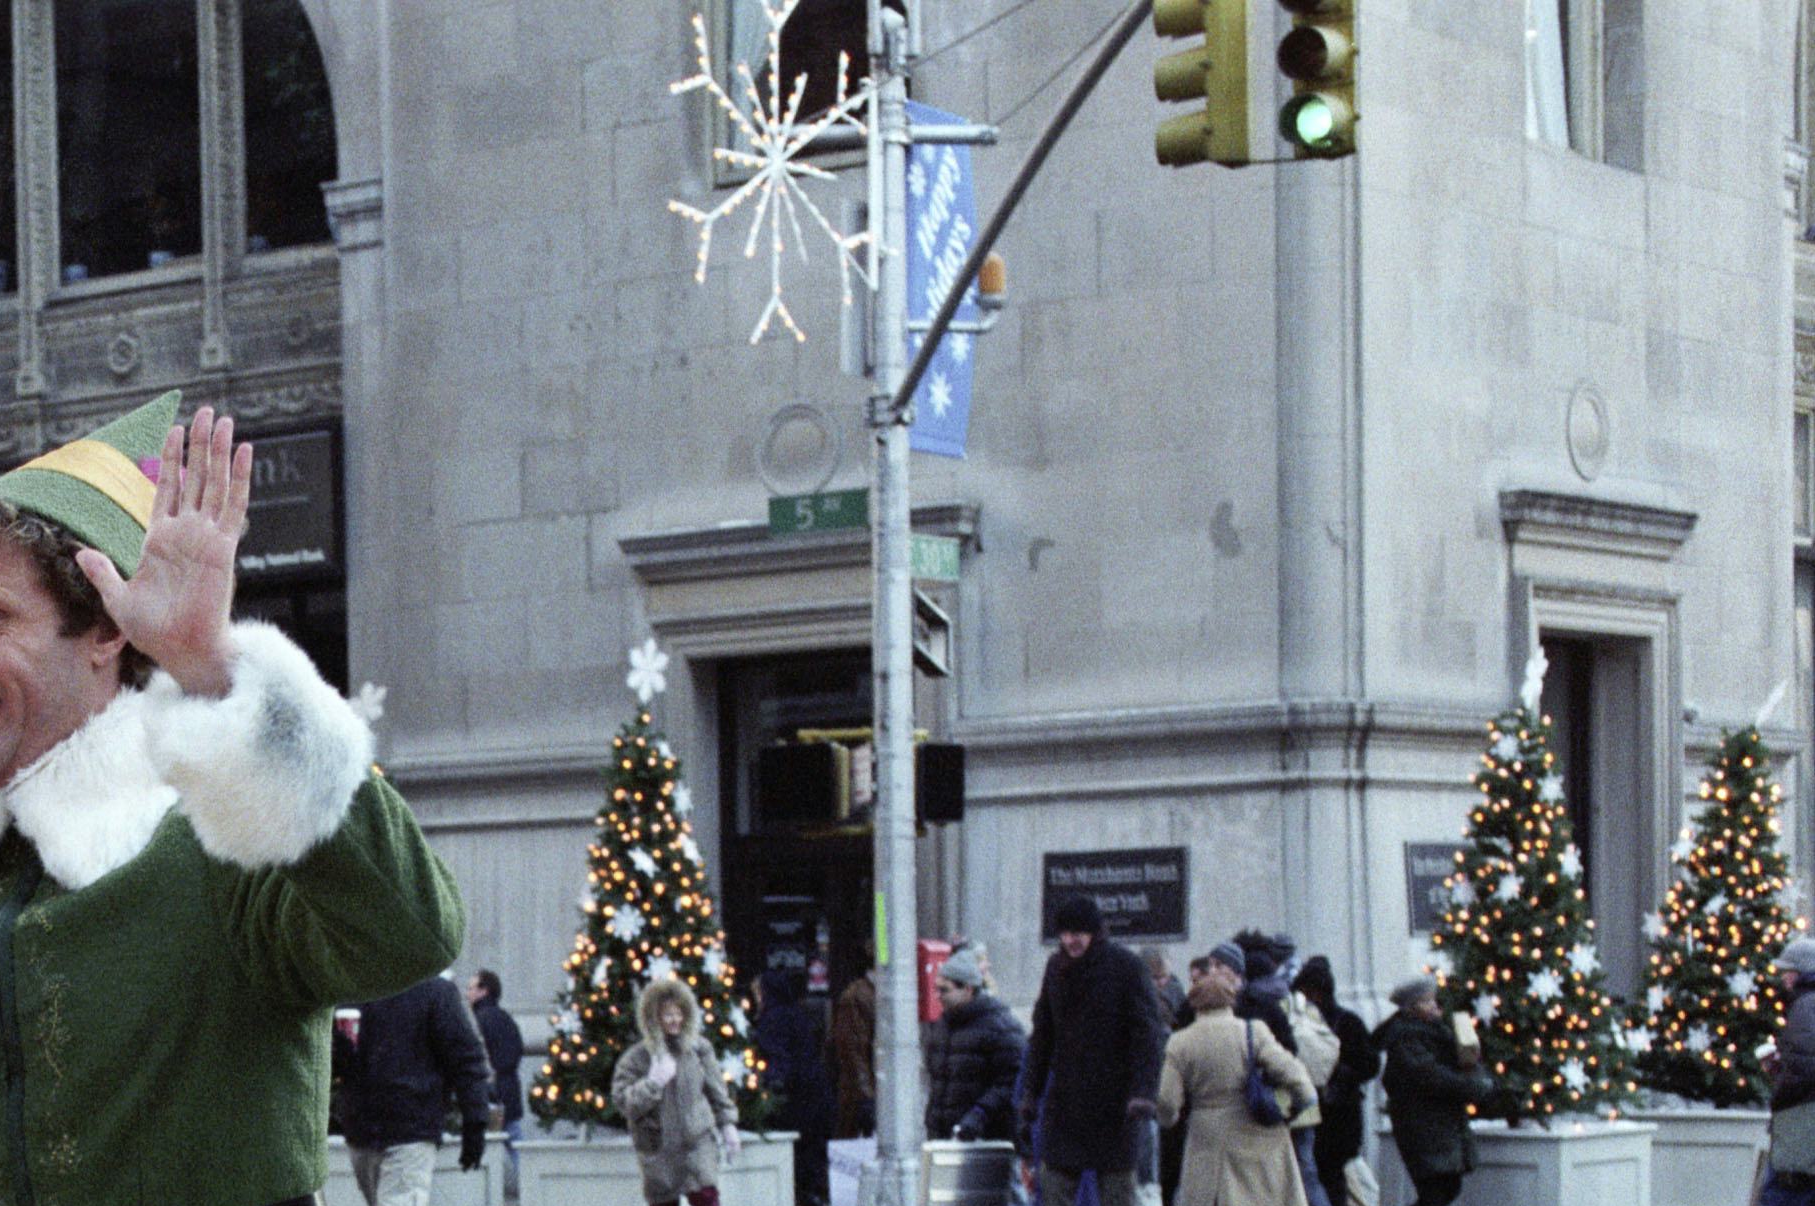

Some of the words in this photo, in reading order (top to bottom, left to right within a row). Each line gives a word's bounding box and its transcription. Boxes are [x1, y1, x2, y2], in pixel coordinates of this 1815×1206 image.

[916, 146, 961, 260] Happy
[253, 447, 302, 488] nk
[795, 498, 815, 531] 5
